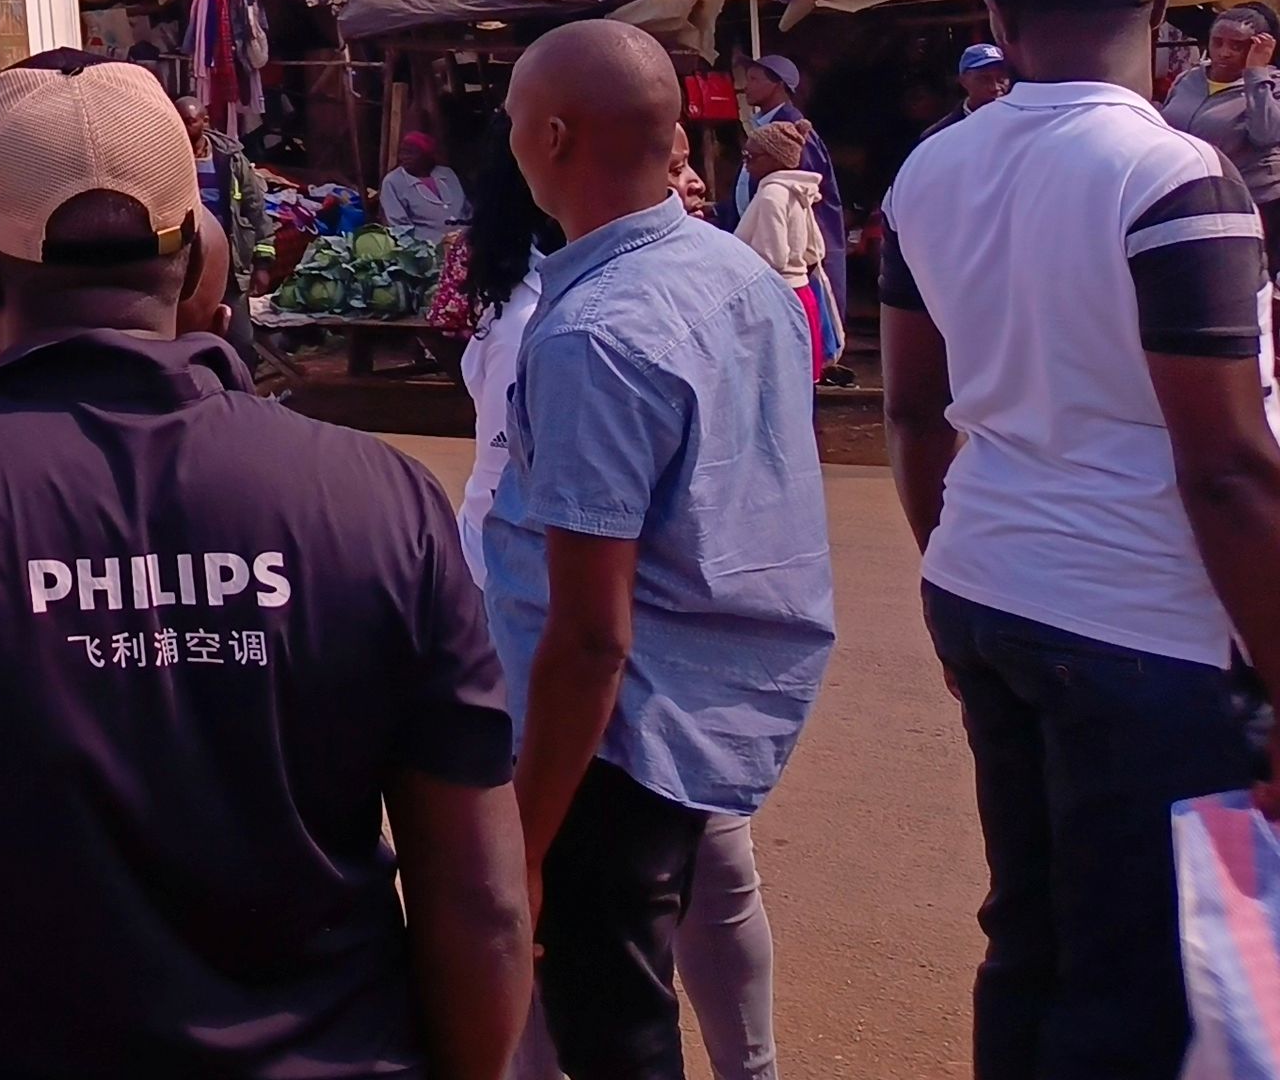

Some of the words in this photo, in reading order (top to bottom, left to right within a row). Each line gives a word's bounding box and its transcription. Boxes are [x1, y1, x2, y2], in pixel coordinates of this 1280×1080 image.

[27, 551, 292, 613] PHILIPS
[67, 627, 268, 668] 飞利浦空调
